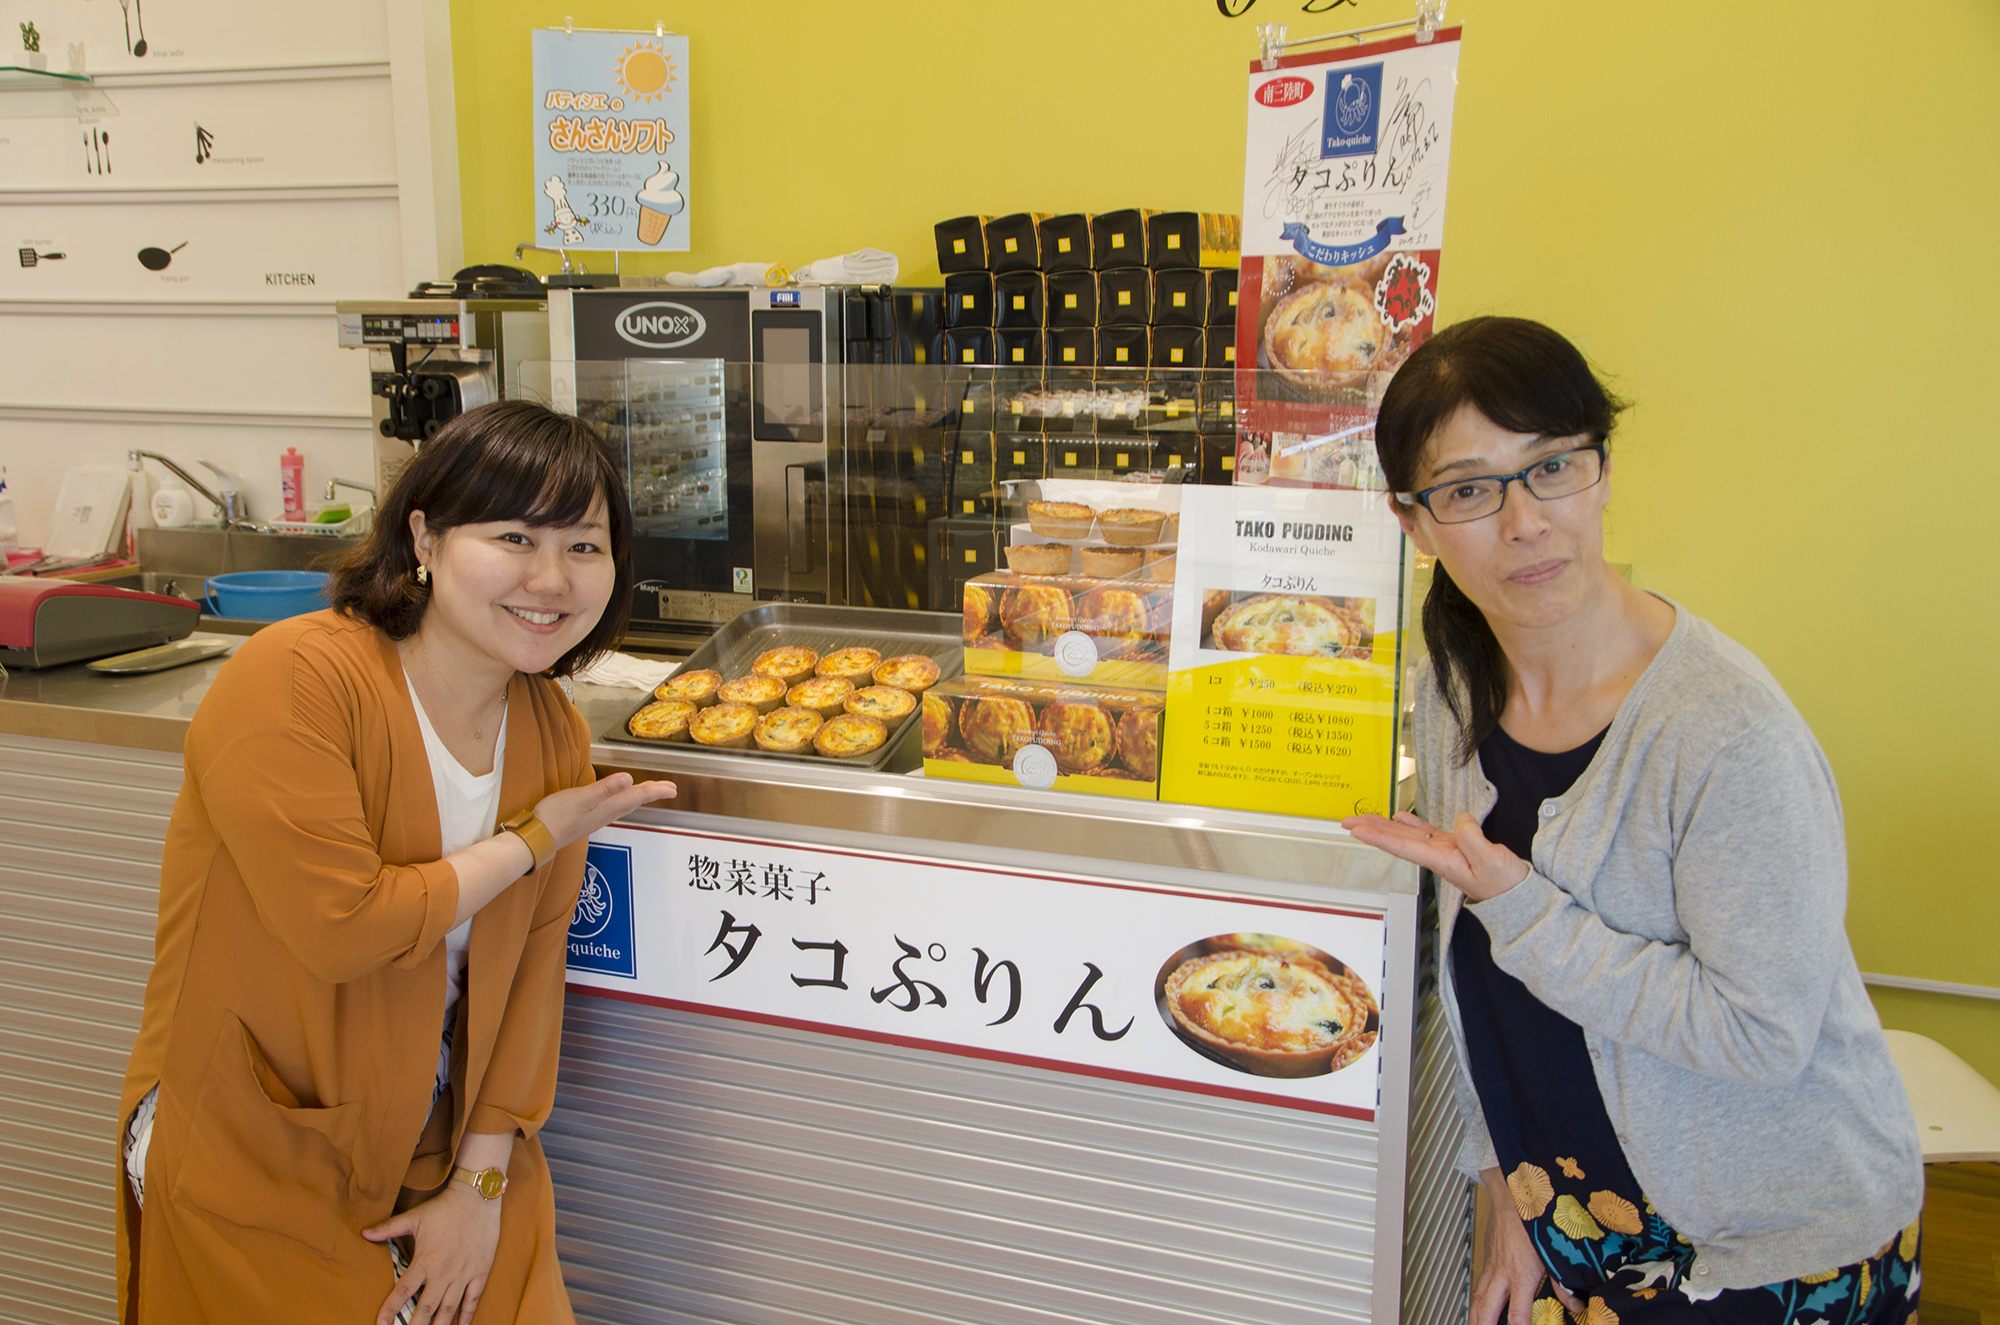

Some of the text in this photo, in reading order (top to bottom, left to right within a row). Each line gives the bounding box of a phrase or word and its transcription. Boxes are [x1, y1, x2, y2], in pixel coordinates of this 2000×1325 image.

[1263, 81, 1305, 105] 南三陸町
[549, 115, 675, 155] さんさんソフト
[1326, 134, 1372, 149] Tako-quiche
[1290, 157, 1404, 195] タコぷりん
[1308, 245, 1375, 263] こだわりキッシュ
[265, 273, 315, 286] KITCHEN
[1235, 520, 1353, 542] TAKO PUDDING
[1249, 542, 1335, 556] Kodawari Quiche
[640, 584, 659, 593] Maps
[1262, 574, 1318, 592] タコぷりん
[979, 682, 1138, 702] TAKO PUDDING
[1249, 678, 1275, 689] ¥250
[1297, 681, 1358, 696] (税込¥270)
[1241, 708, 1274, 720] ¥1000
[1289, 711, 1354, 726] (税込¥1080)
[1011, 735, 1062, 747] TAKOPUDDING
[1240, 723, 1273, 735] ¥1250
[1288, 726, 1353, 742] (税込¥1350)
[1239, 738, 1272, 750] ¥1500
[1286, 742, 1352, 758] (税込¥1620)
[688, 854, 832, 905] 惣菜菓子
[567, 942, 621, 960] -quiche
[703, 910, 1136, 1041] タコぷりん
